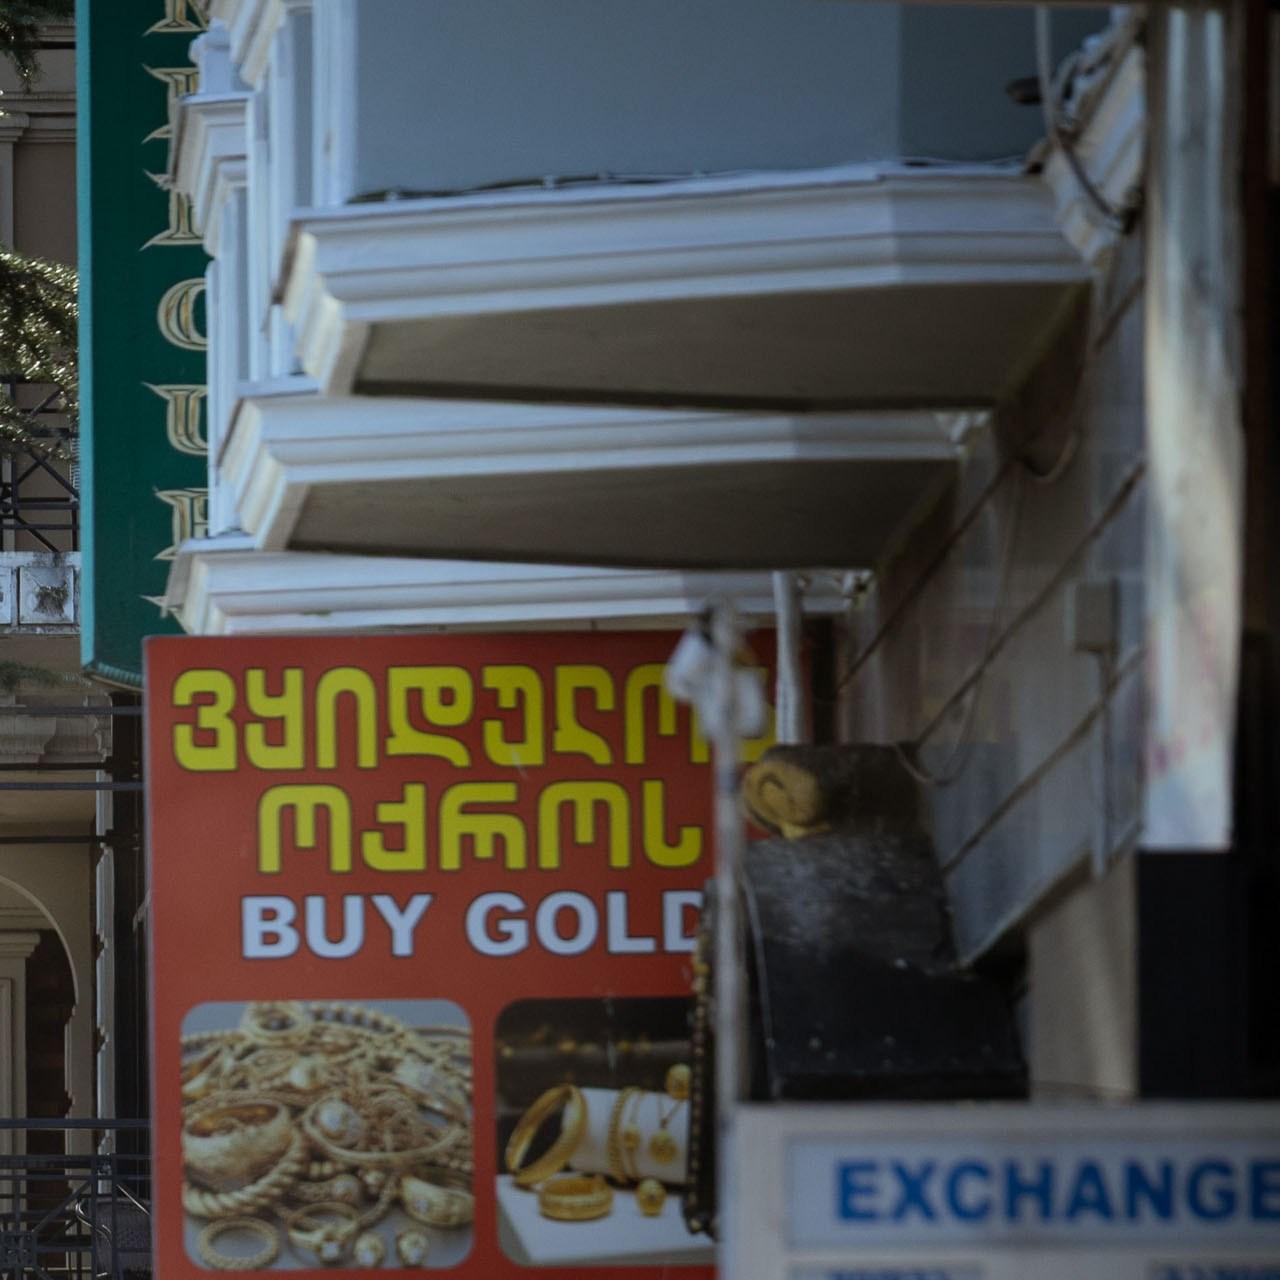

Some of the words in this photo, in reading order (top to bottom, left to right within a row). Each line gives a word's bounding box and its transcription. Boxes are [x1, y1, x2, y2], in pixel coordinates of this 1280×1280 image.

[258, 779, 703, 874] ოქროს
[241, 894, 433, 959] BUY
[465, 889, 704, 956] GOLD
[834, 1158, 1280, 1224] EXCHANGE
